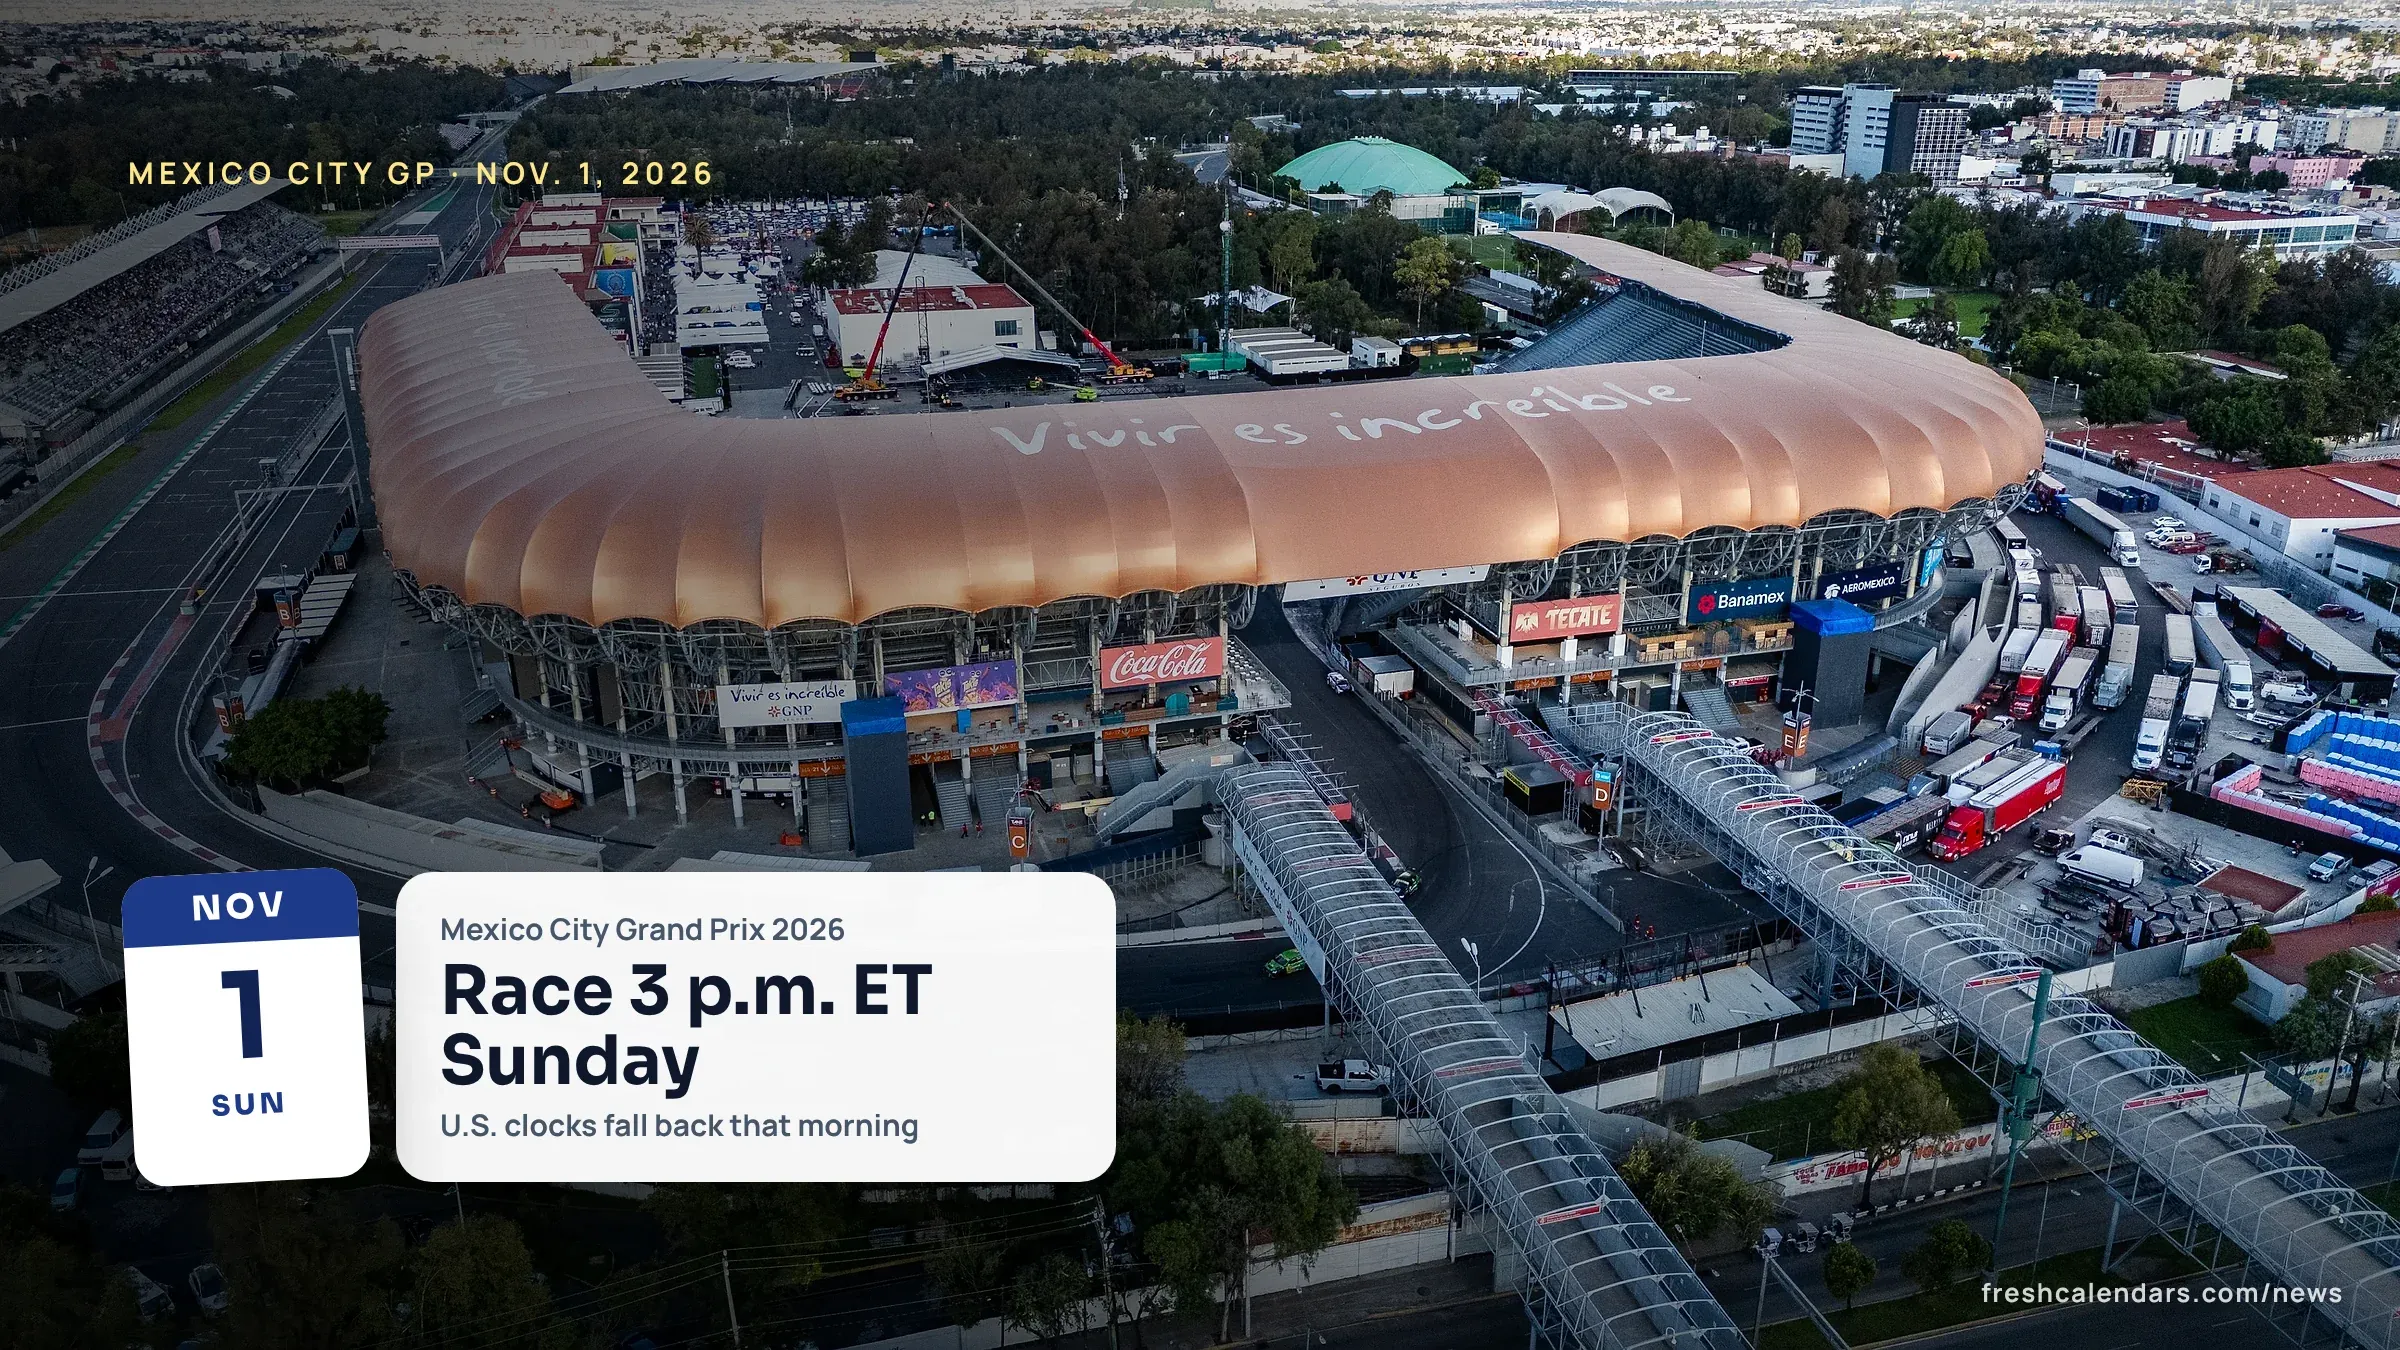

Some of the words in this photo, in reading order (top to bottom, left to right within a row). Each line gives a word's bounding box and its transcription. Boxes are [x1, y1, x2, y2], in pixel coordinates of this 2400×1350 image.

[990, 418, 1201, 455] Vivir
[1234, 422, 1308, 445] es
[1329, 381, 1691, 441] increíble
[1841, 576, 1894, 594] AEROMEXICO
[1718, 591, 1785, 609] Banamex
[280, 609, 290, 620] B
[1545, 603, 1615, 630] TECATE
[1110, 641, 1212, 684] Coca-Cola
[730, 688, 763, 703] Vivir
[768, 691, 780, 701] es
[785, 684, 845, 700] increíble
[782, 705, 812, 716] GNP
[219, 714, 229, 727] B
[1784, 734, 1794, 748] E
[1799, 735, 1807, 749] E
[1595, 787, 1608, 801] D
[1012, 835, 1025, 849] C
